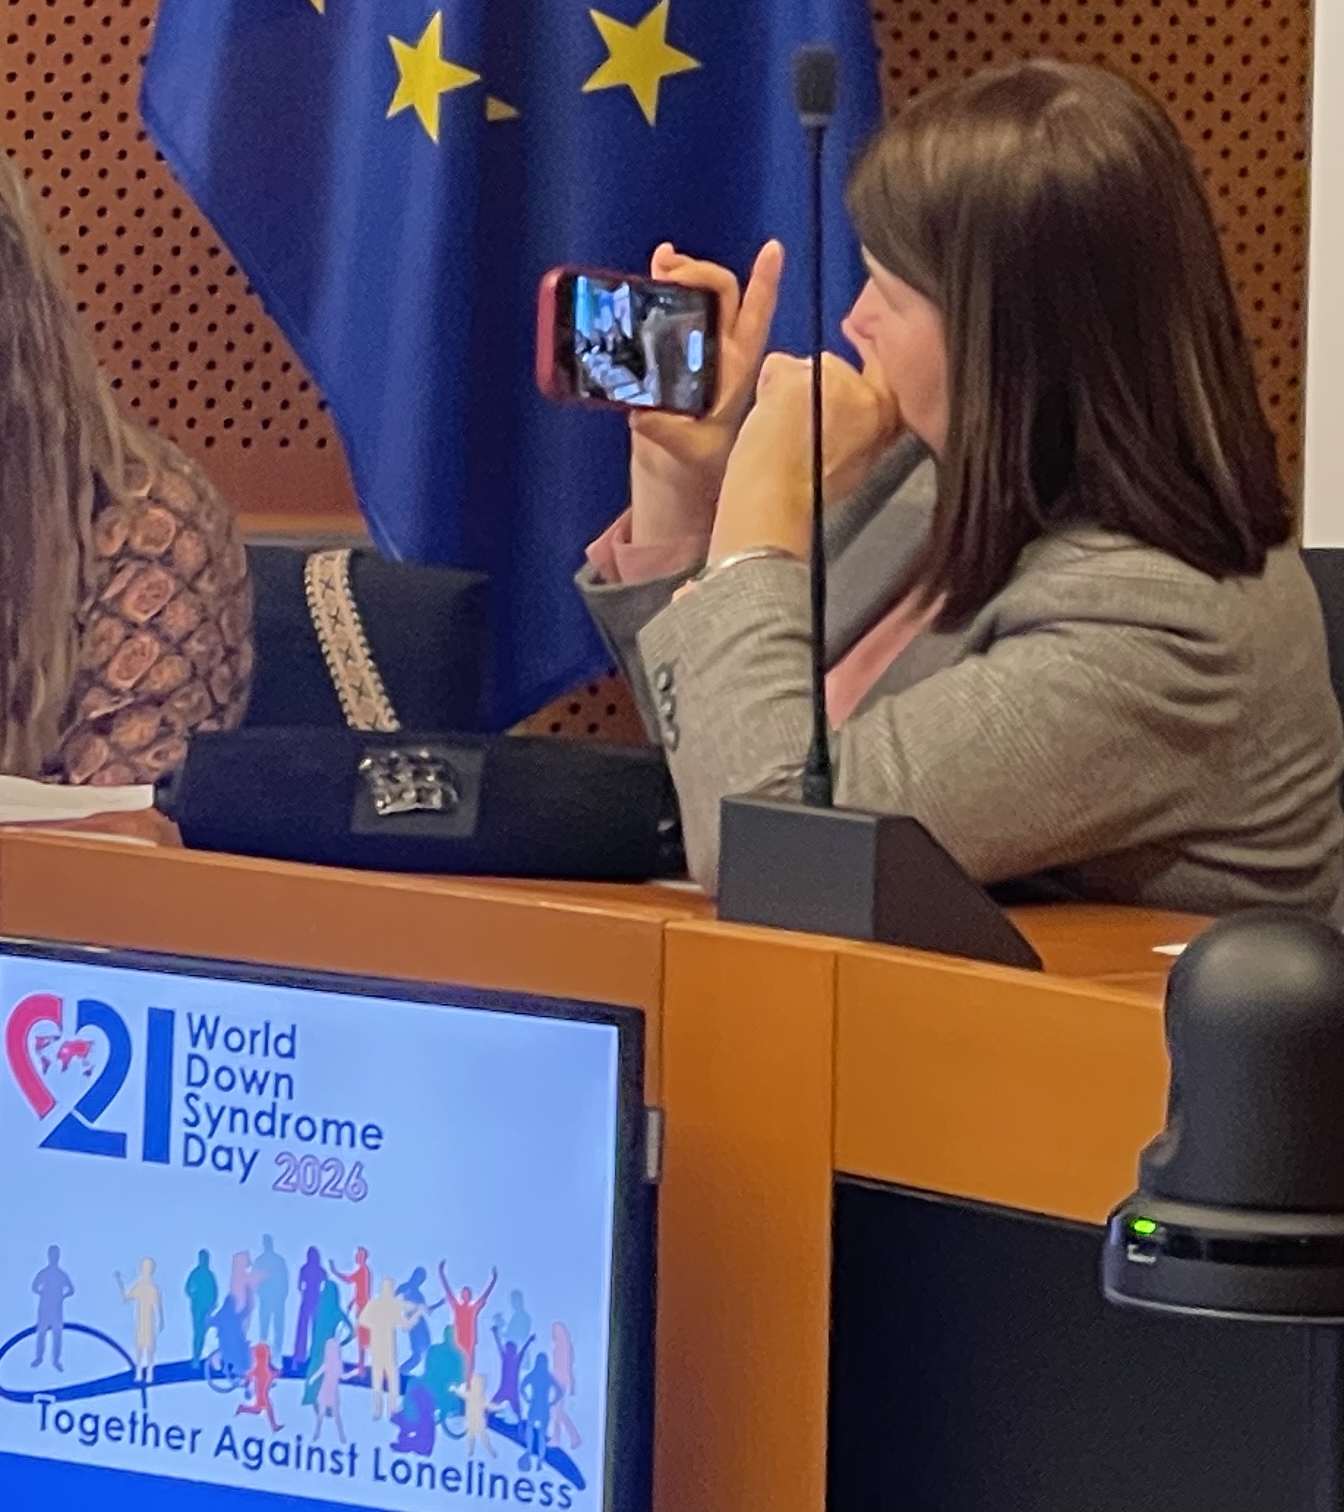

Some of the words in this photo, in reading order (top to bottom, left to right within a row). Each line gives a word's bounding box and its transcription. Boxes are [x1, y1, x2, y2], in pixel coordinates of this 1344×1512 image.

[186, 1011, 298, 1059] World
[185, 1053, 294, 1100] Down
[182, 1092, 385, 1151] Syndrome
[182, 1132, 261, 1184] Day
[271, 1152, 370, 1203] 2026
[32, 1399, 202, 1454] Together
[213, 1424, 358, 1478] Against
[371, 1451, 573, 1509] Loneliness
